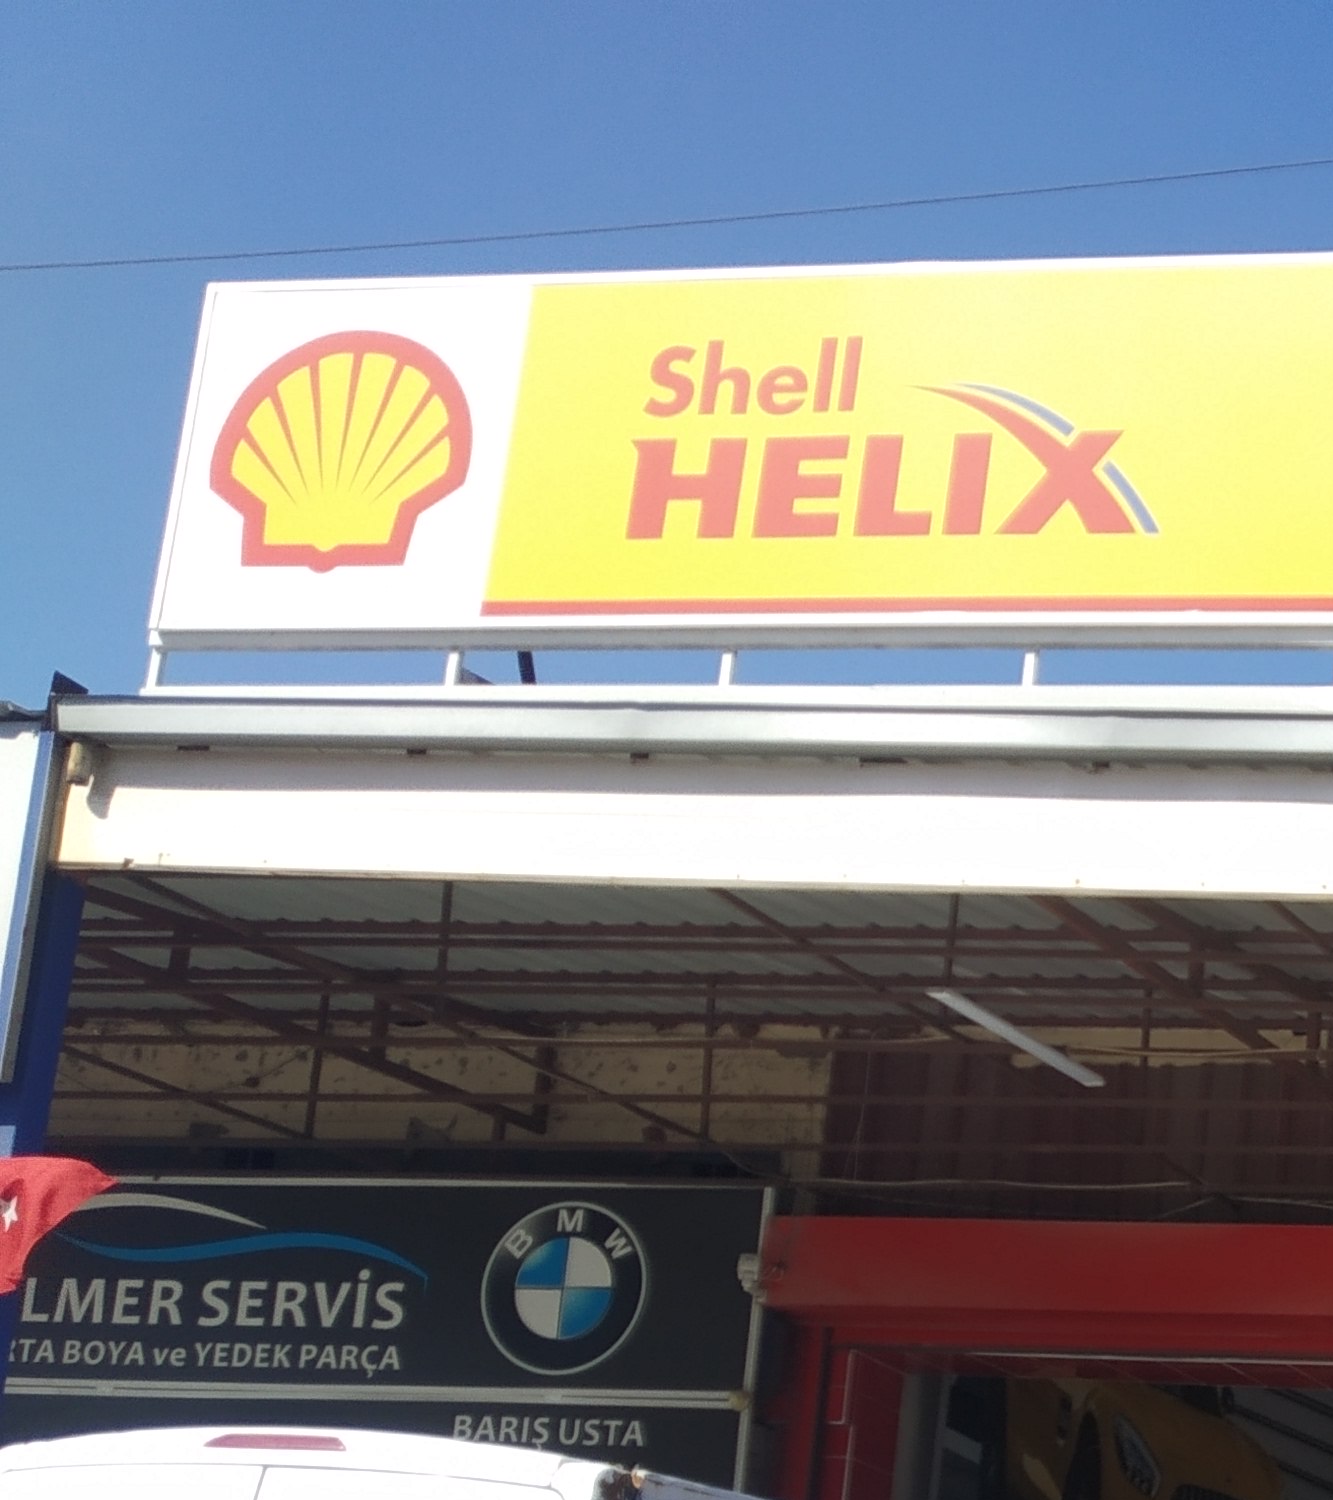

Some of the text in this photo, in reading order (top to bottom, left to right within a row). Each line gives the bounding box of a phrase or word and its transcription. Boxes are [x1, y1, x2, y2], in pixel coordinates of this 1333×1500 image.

[643, 336, 863, 418] Shell
[626, 386, 1150, 540] HELIX
[504, 1208, 632, 1259] BMW
[197, 1268, 405, 1330] SERVİS
[62, 1340, 145, 1366] BOYA
[153, 1347, 187, 1367] ve
[195, 1342, 292, 1369] YEDEK
[298, 1344, 401, 1378] PARÇA
[453, 1415, 644, 1450] BARIŞ USTA
